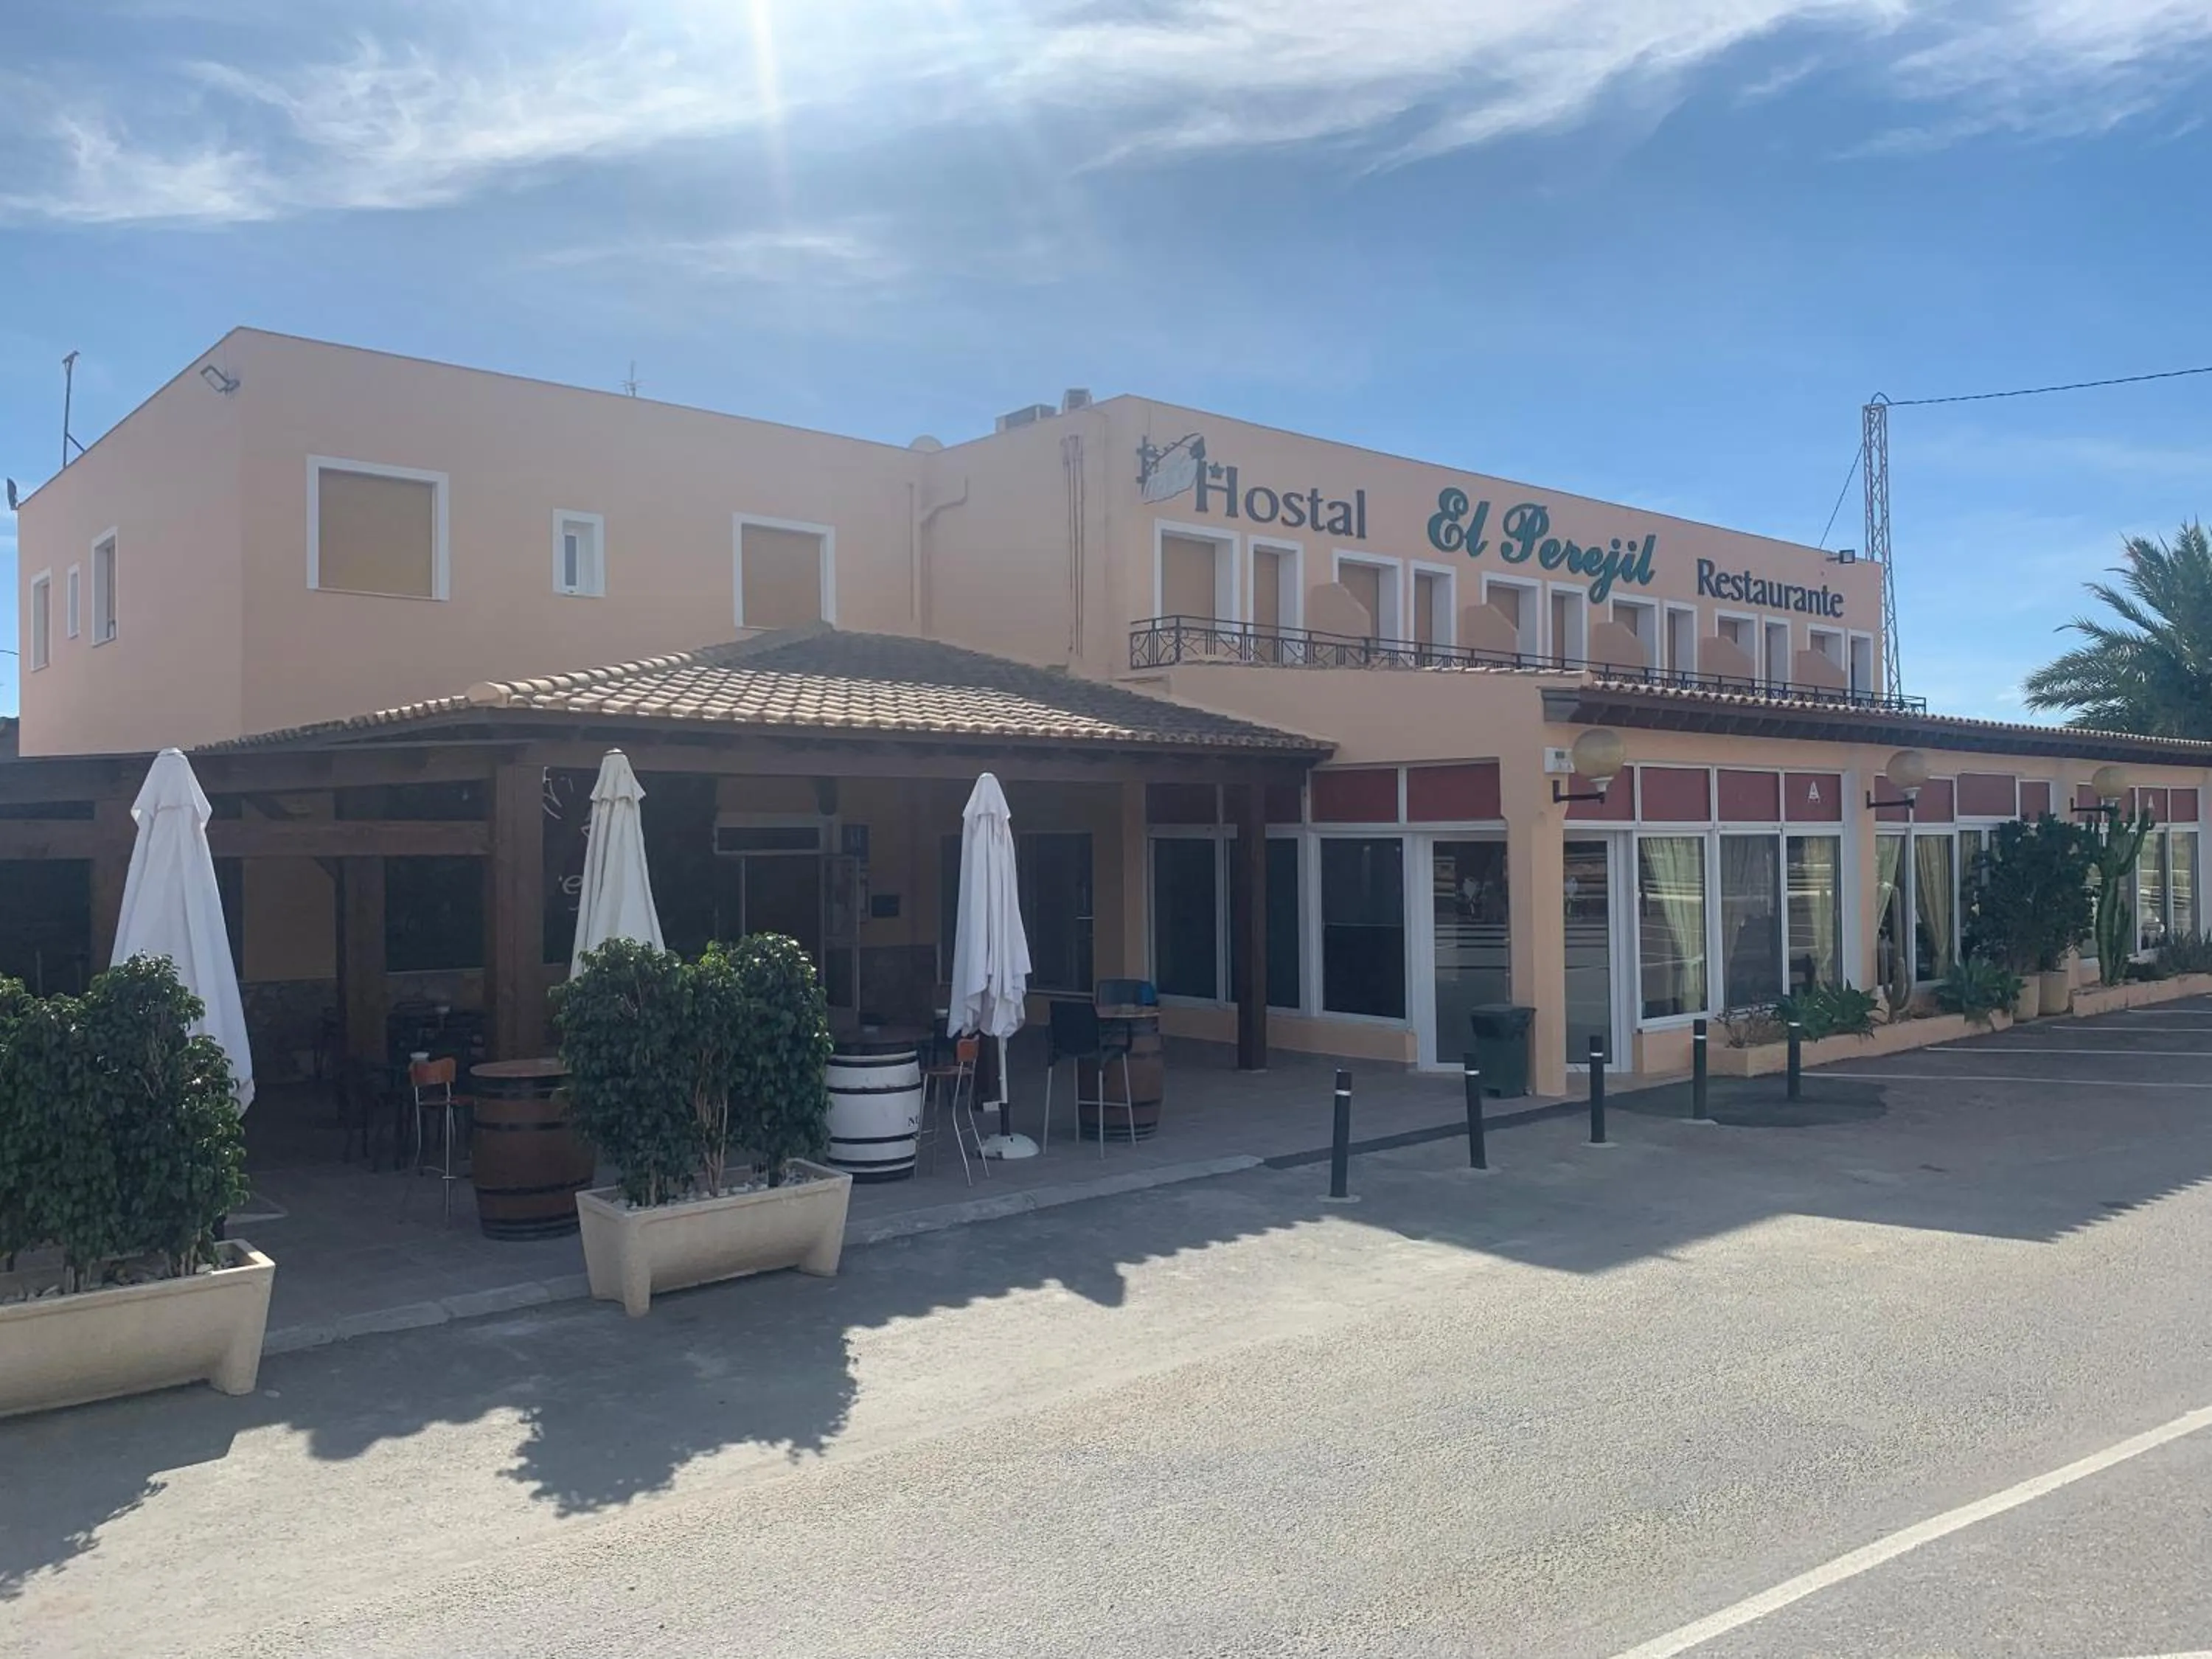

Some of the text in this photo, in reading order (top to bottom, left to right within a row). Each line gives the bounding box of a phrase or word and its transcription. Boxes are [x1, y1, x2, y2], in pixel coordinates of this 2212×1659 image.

[1194, 460, 1366, 539] Hostal
[1427, 487, 1489, 557] El
[1500, 503, 1657, 603] Perejil
[1697, 558, 1845, 618] Restaurante
